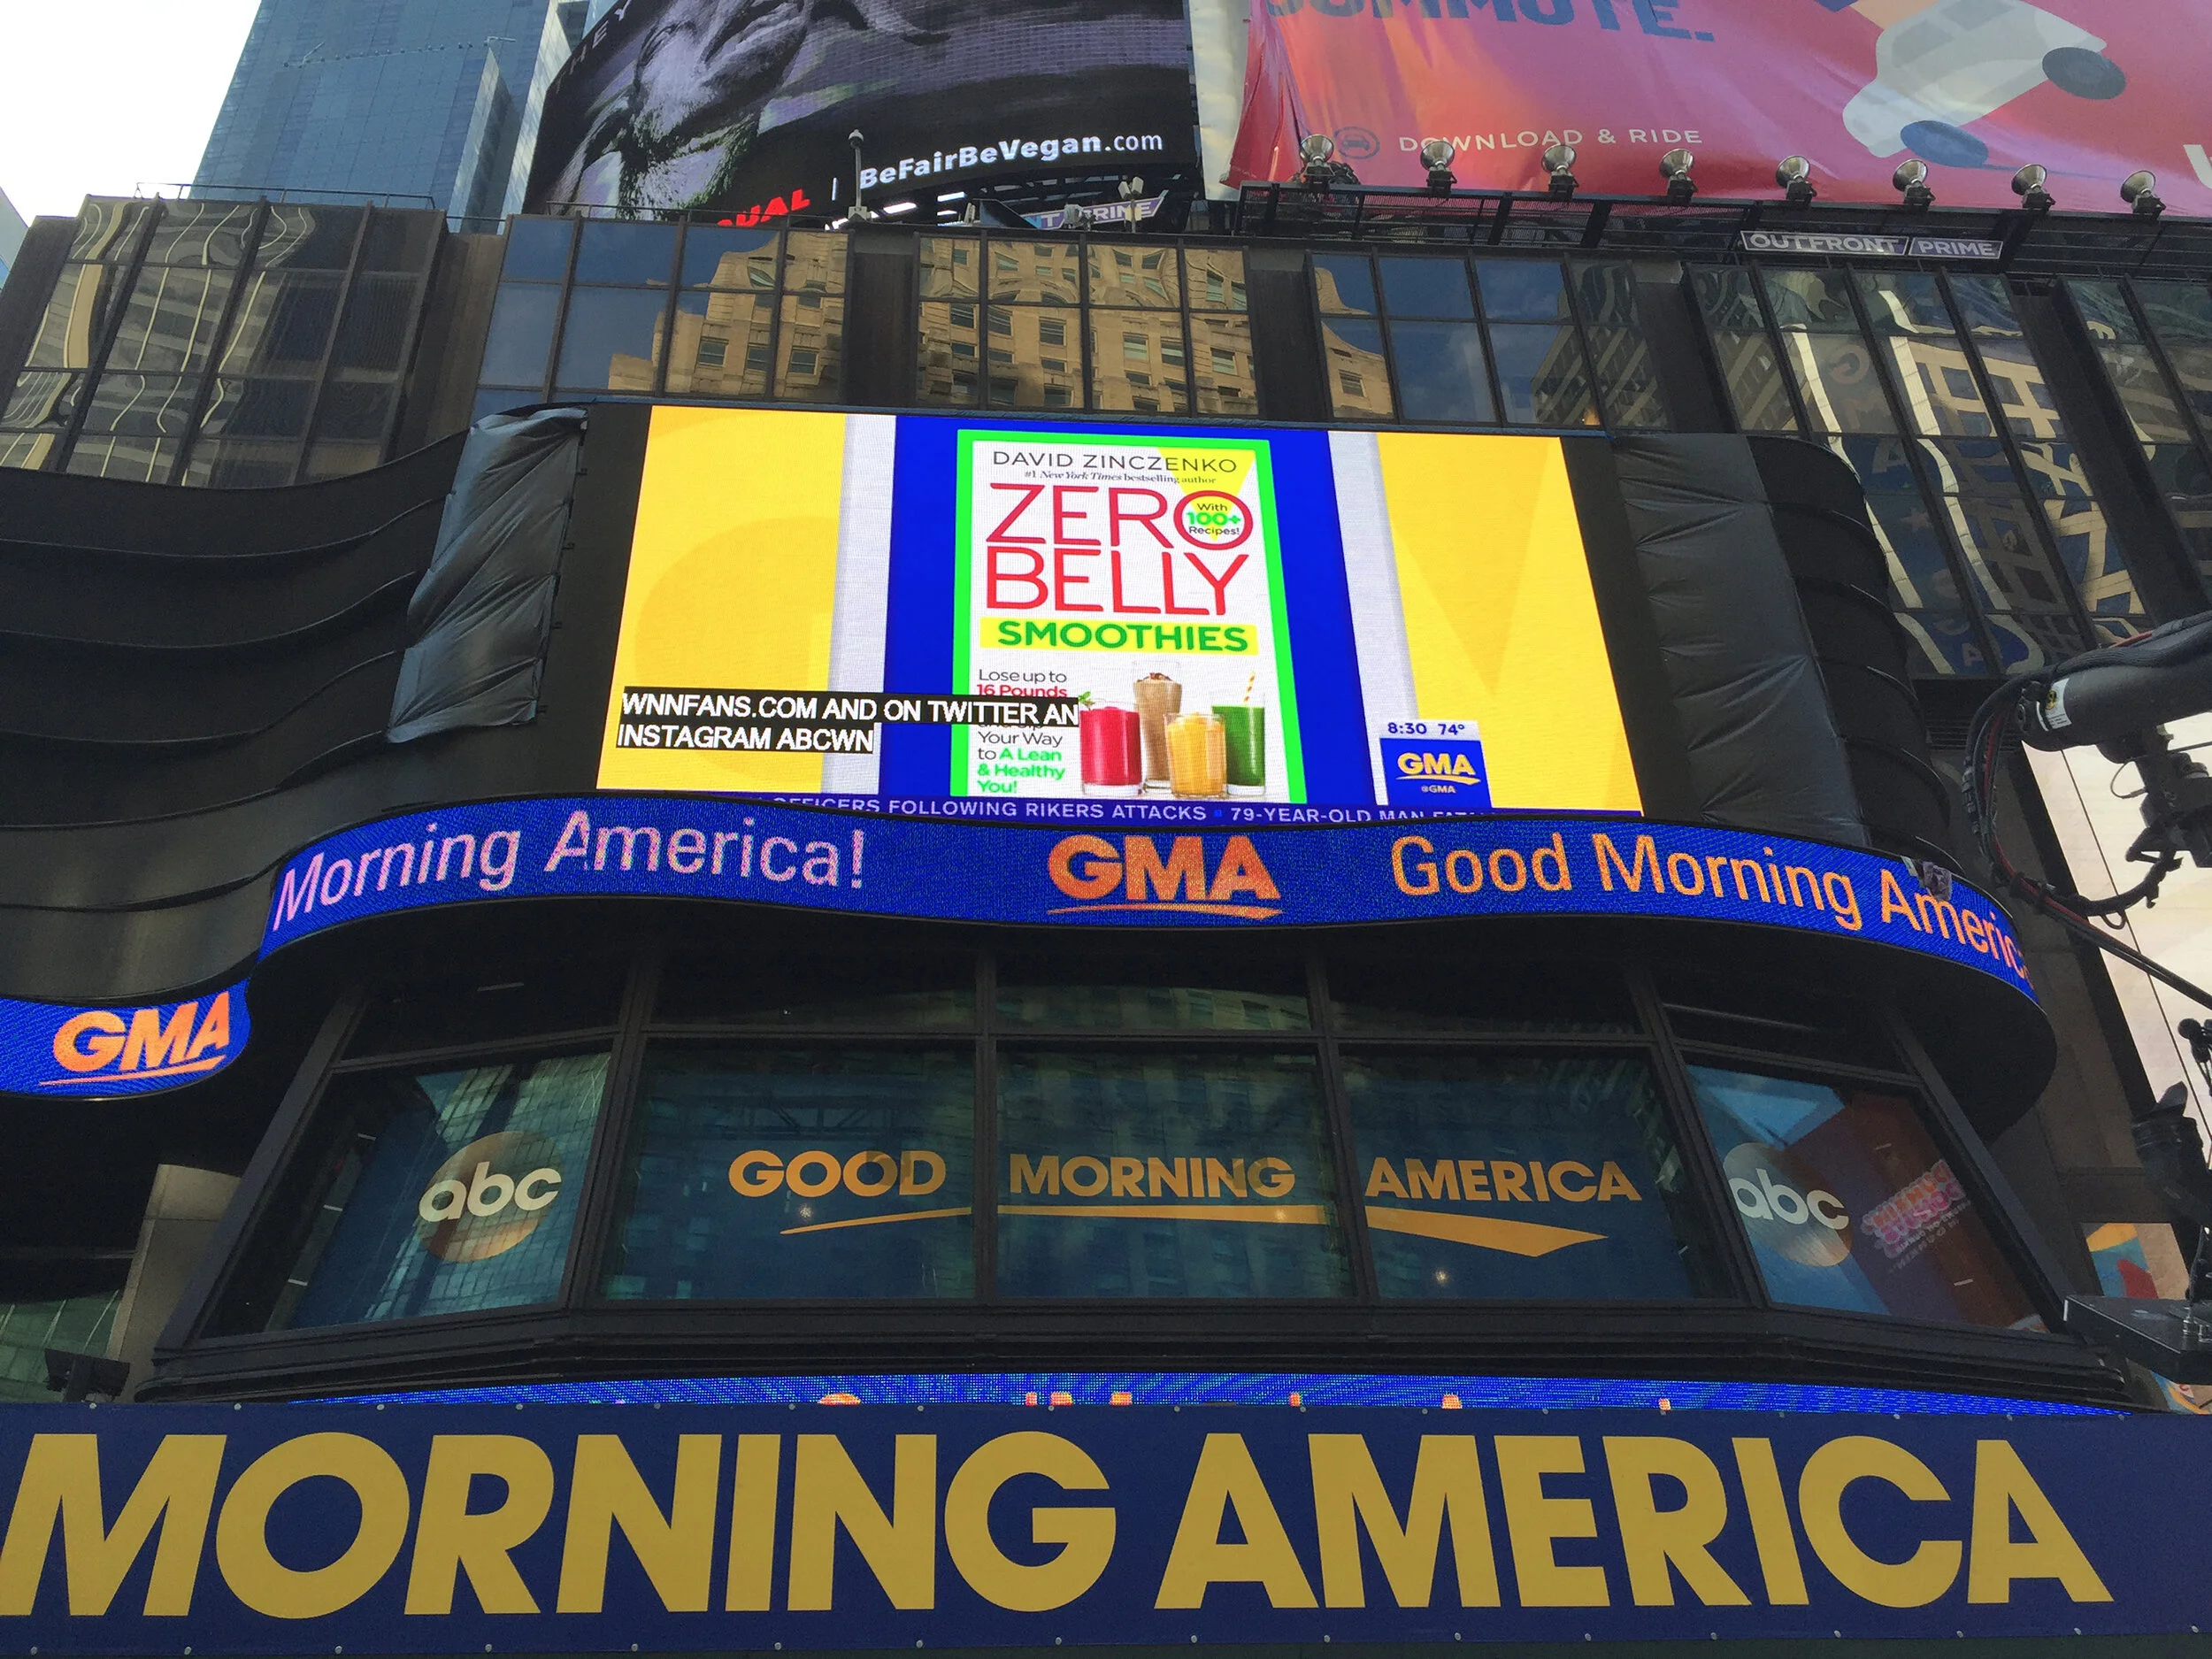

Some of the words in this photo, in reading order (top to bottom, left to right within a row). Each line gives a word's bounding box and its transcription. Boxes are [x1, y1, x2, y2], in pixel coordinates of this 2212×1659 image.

[1599, 129, 1617, 144] &
[1629, 127, 1702, 145] RIDE
[860, 133, 1163, 190] BeFairBeVegan.com
[718, 188, 810, 227] UAL
[1749, 233, 1899, 253] OUTFRONT
[1917, 239, 1995, 257] PRIME
[993, 451, 1073, 468] DAVID
[1083, 454, 1237, 473] ZINCZENKO
[1040, 471, 1064, 480] New
[1064, 471, 1089, 480] York
[1090, 472, 1123, 481] Times
[1124, 473, 1179, 485] bestselling
[1181, 475, 1217, 484] author
[986, 482, 1254, 550] ZERO
[1186, 511, 1241, 526] 100+
[1196, 503, 1228, 512] With
[1188, 526, 1240, 536] Recipes!
[986, 545, 1249, 616] BELLY
[998, 619, 1249, 652] SMOOTHIES
[979, 668, 1020, 682] Lose
[1023, 672, 1046, 685] up
[1049, 671, 1067, 683] to
[977, 684, 995, 696] 16
[1000, 685, 1068, 697] Pounds
[622, 692, 821, 719] WNNFANS.COM
[821, 697, 878, 722] AND
[883, 698, 924, 723] ON
[927, 700, 1040, 725] TWITTER
[1043, 703, 1079, 726] AN
[618, 725, 772, 749] INSTAGRAM
[775, 728, 874, 752] ABCWN
[978, 731, 1019, 744] Your
[1022, 732, 1064, 749] Way
[1387, 722, 1427, 734] 8:30
[978, 748, 997, 760] to
[999, 747, 1014, 761] A
[1018, 748, 1063, 762] Lean
[1397, 752, 1477, 776] GMA
[977, 763, 990, 776] &
[995, 764, 1066, 780] Healthy
[977, 780, 1018, 794] You!
[1421, 785, 1456, 794] @GMA
[888, 799, 1018, 817] FOLLOWING
[1025, 803, 1104, 818] RIKERS
[1111, 804, 1207, 820] ATTACKS
[1231, 807, 1371, 823] 79-YEAR-OLD
[273, 823, 521, 933] Morning
[544, 810, 865, 889] America!
[1048, 834, 1281, 901] GMA
[1390, 832, 1573, 896] Good
[1591, 833, 1863, 932] Morning
[53, 991, 230, 1073] GMA
[728, 1149, 947, 1198] GOOD
[1010, 1153, 1296, 1199] MORNING
[1363, 1156, 1643, 1202] AMERICA
[419, 1161, 562, 1223] abc
[1728, 1168, 1849, 1230] abc
[0, 1430, 1117, 1620] MORNING
[1154, 1432, 2114, 1609] AMERICA
